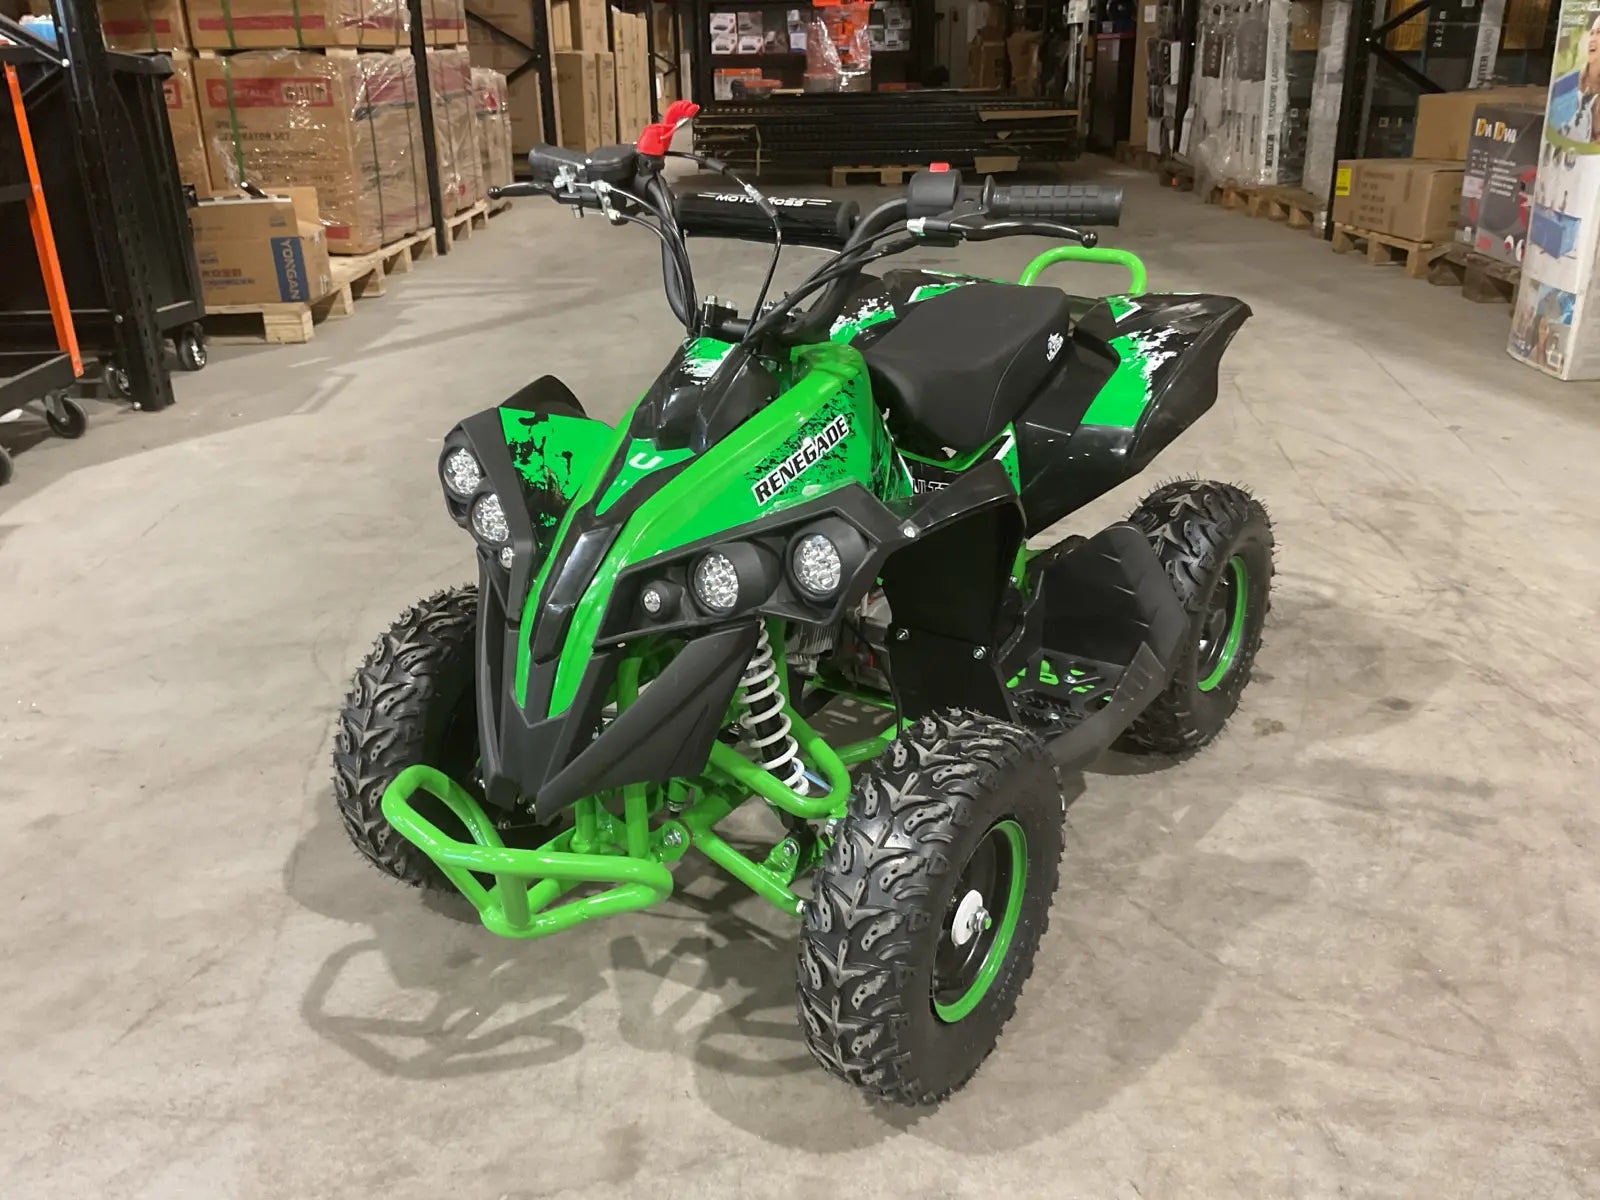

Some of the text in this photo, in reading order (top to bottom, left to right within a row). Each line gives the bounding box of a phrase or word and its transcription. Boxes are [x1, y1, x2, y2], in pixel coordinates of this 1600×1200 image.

[715, 193, 807, 207] MOTOROSS
[279, 239, 301, 300] YONGAN
[752, 414, 849, 506] RENEGADE
